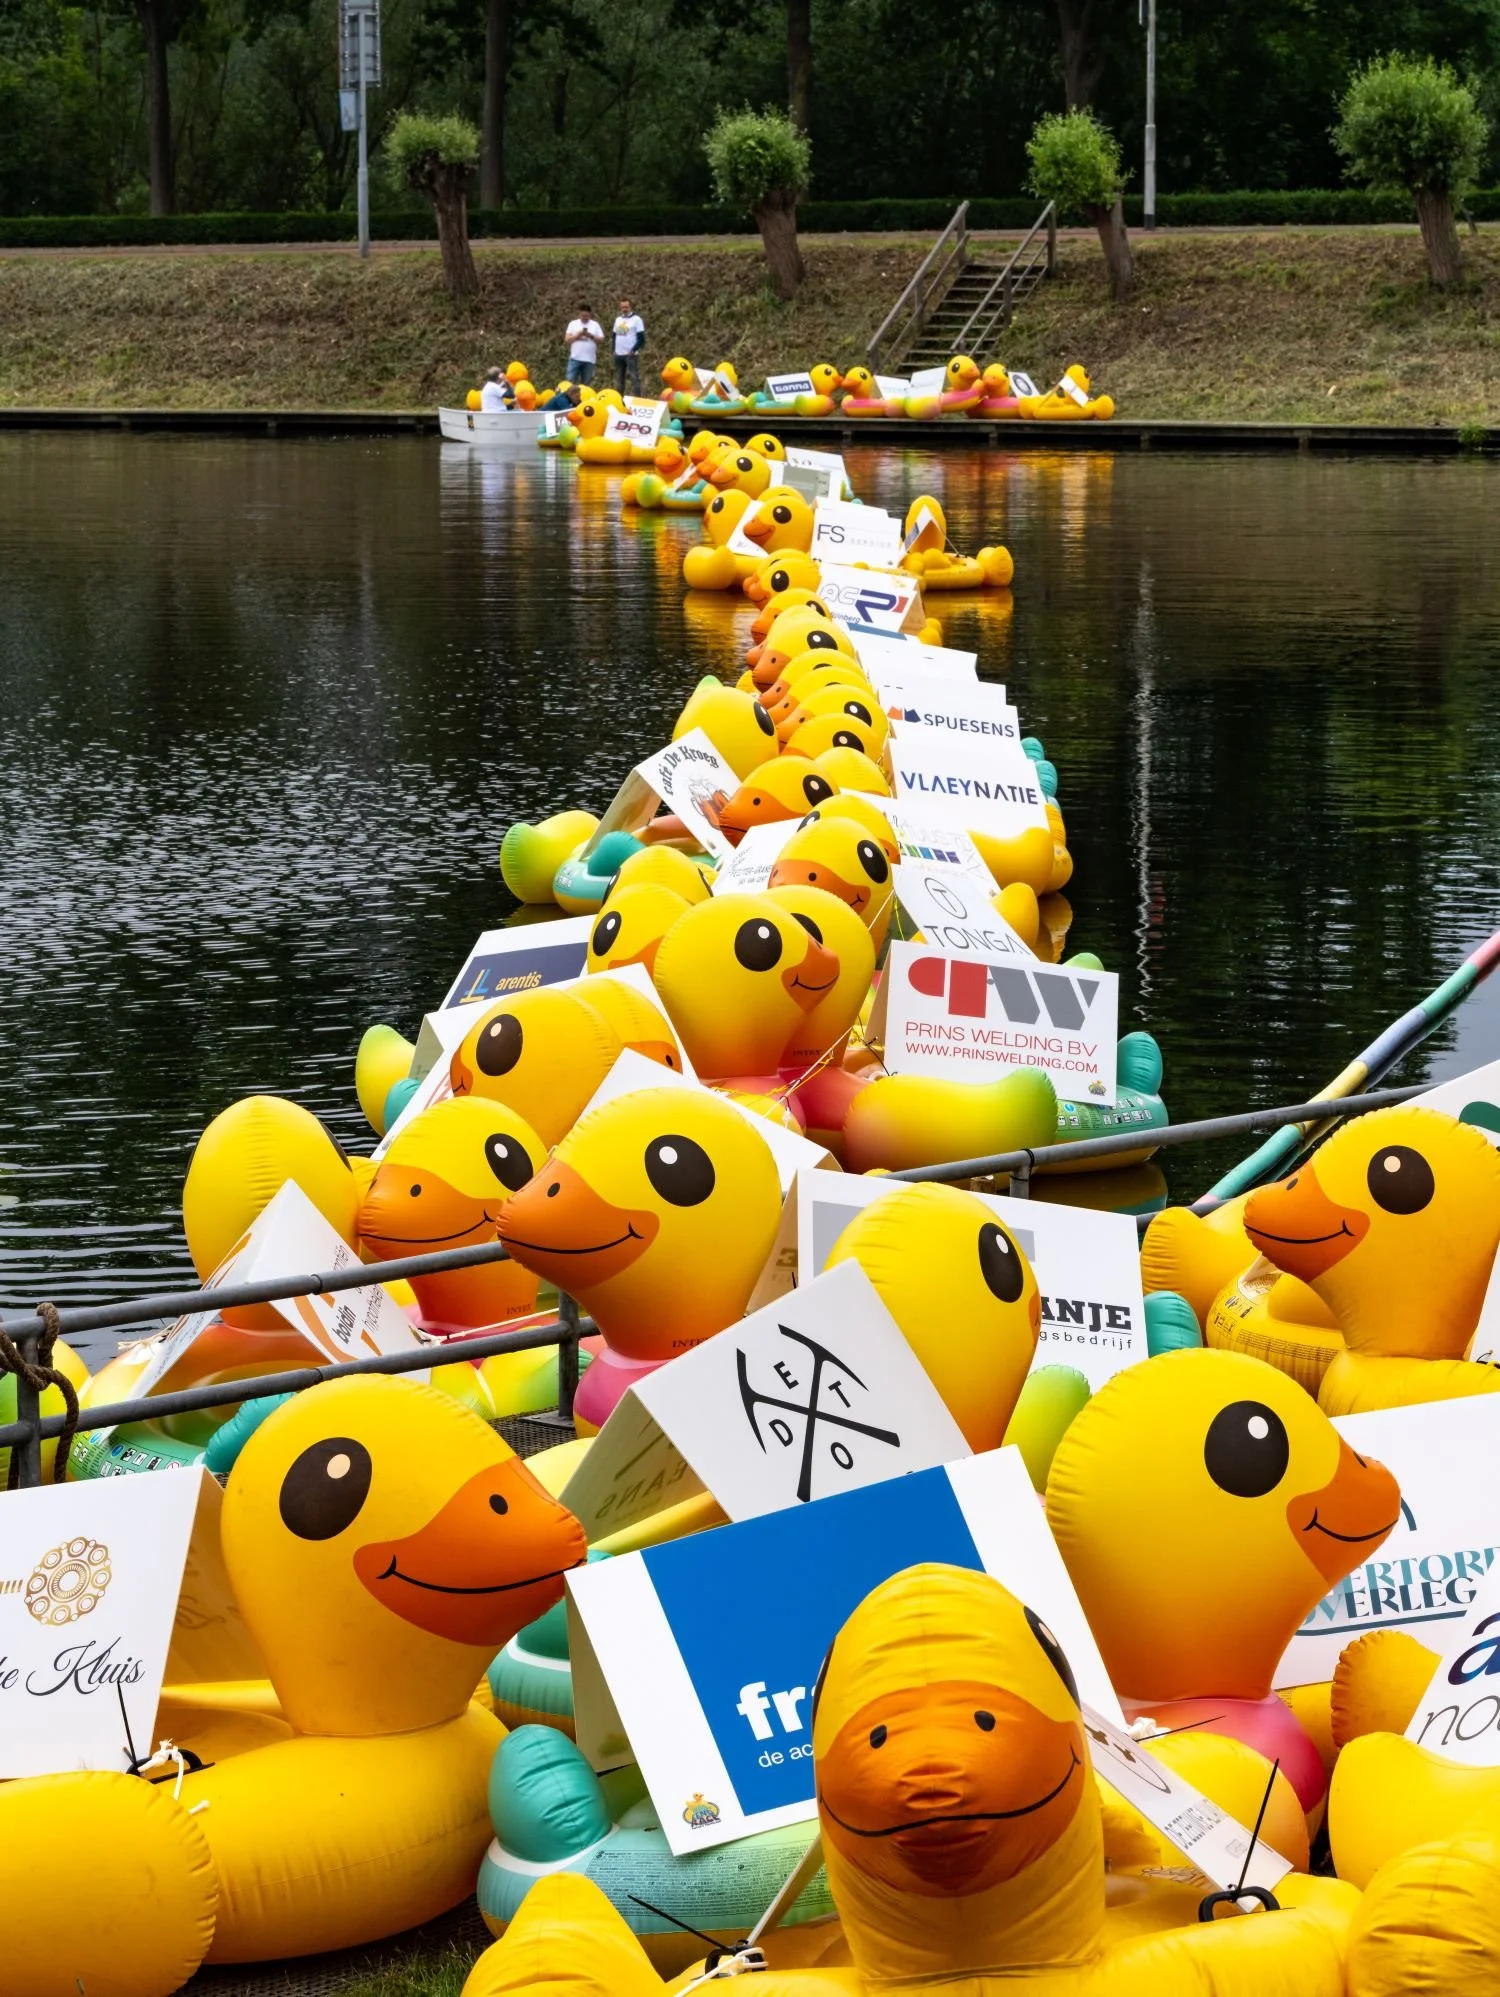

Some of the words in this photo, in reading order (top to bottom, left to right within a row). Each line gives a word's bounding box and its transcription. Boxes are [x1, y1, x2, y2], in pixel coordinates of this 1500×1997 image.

[817, 524, 845, 543] FS
[924, 713, 1015, 738] SPUESENS
[901, 770, 1038, 805] VLAEYNATIE
[923, 925, 1031, 955] TONGA
[495, 971, 542, 991] arentis
[906, 1021, 965, 1042] PRINS
[971, 1028, 1063, 1053] WELDING
[1068, 1040, 1098, 1057] BV
[906, 1042, 1098, 1074] WWW.PRINSWELDING.COM
[672, 1336, 709, 1348] INTE
[26, 1636, 146, 1696] Kluis
[736, 1680, 816, 1741] fr
[1417, 1695, 1500, 1746] no
[758, 1750, 785, 1768] de
